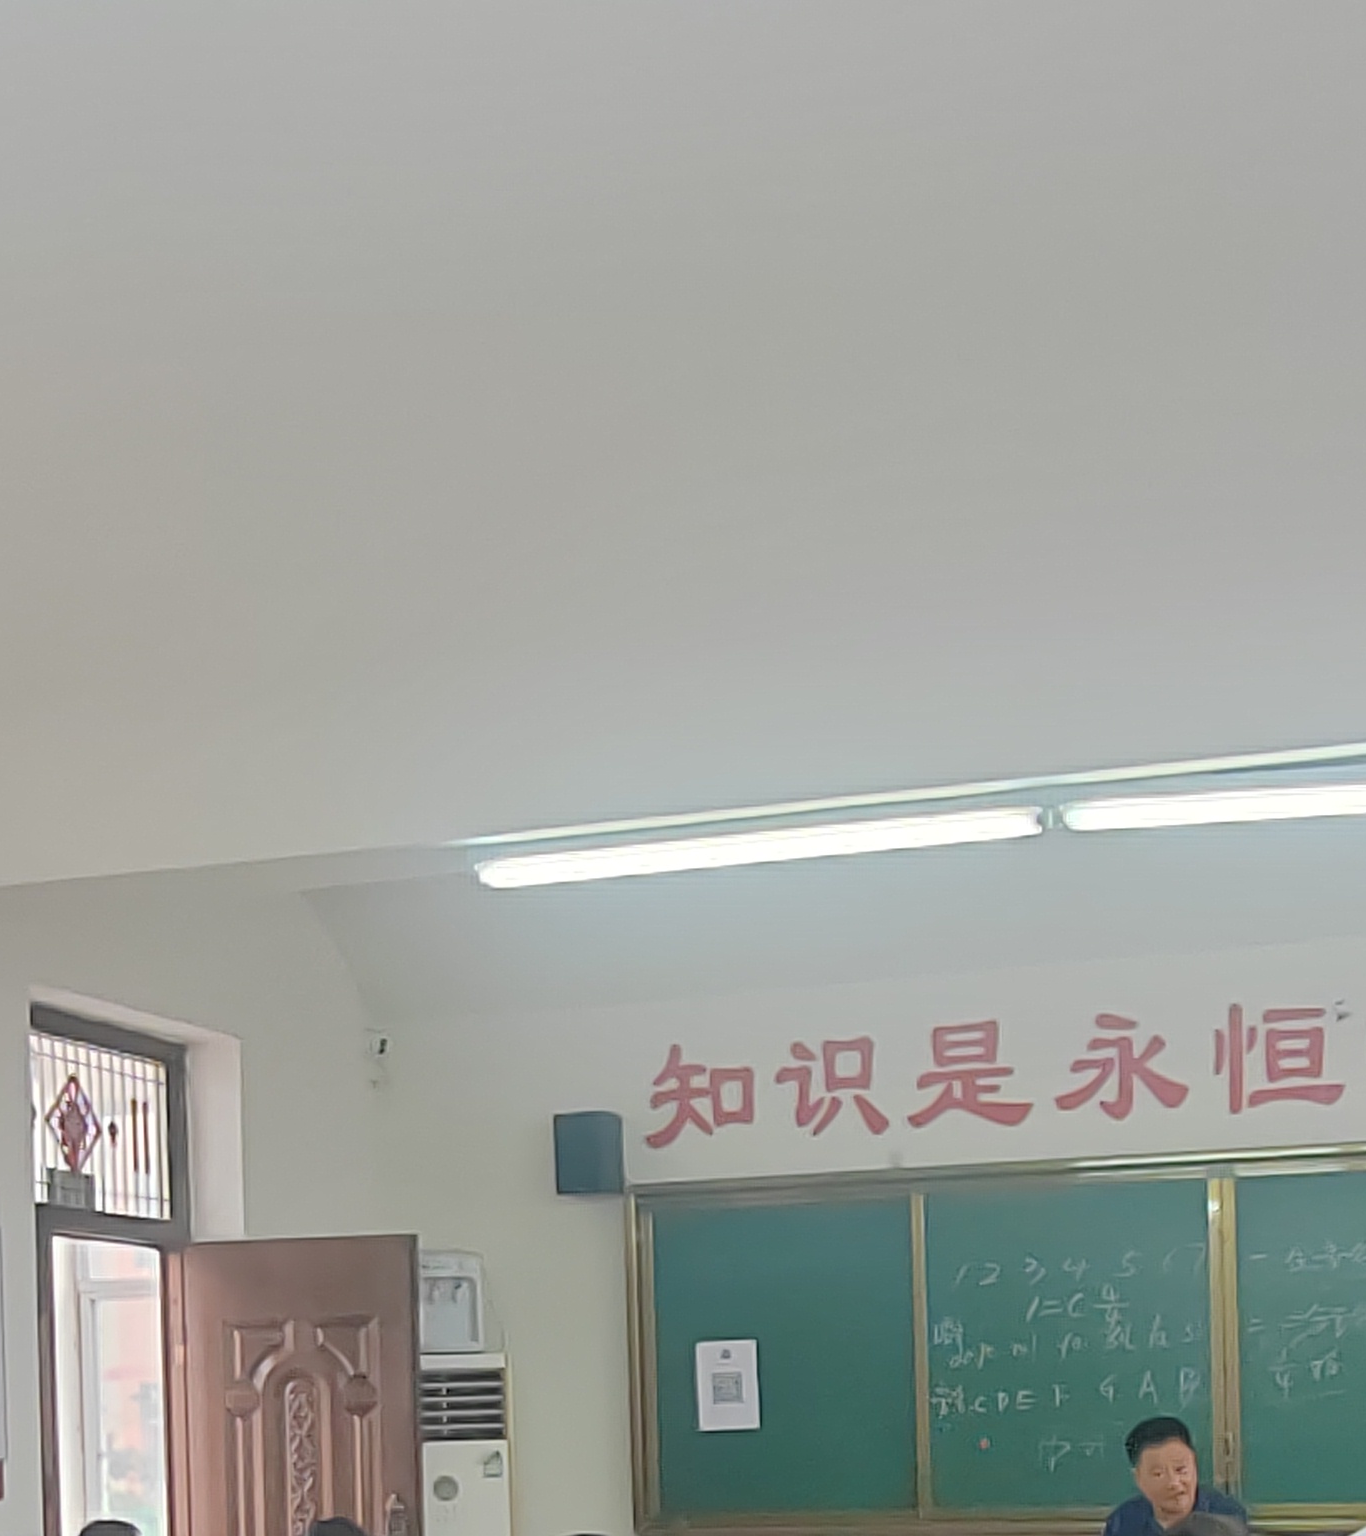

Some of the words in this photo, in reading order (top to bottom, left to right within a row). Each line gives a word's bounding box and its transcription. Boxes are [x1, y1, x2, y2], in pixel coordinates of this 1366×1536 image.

[979, 1263, 1001, 1286] 2
[1062, 1257, 1090, 1282] 4
[1113, 1251, 1142, 1278] 5
[1015, 1390, 1037, 1410] E
[1138, 1369, 1159, 1405] A
